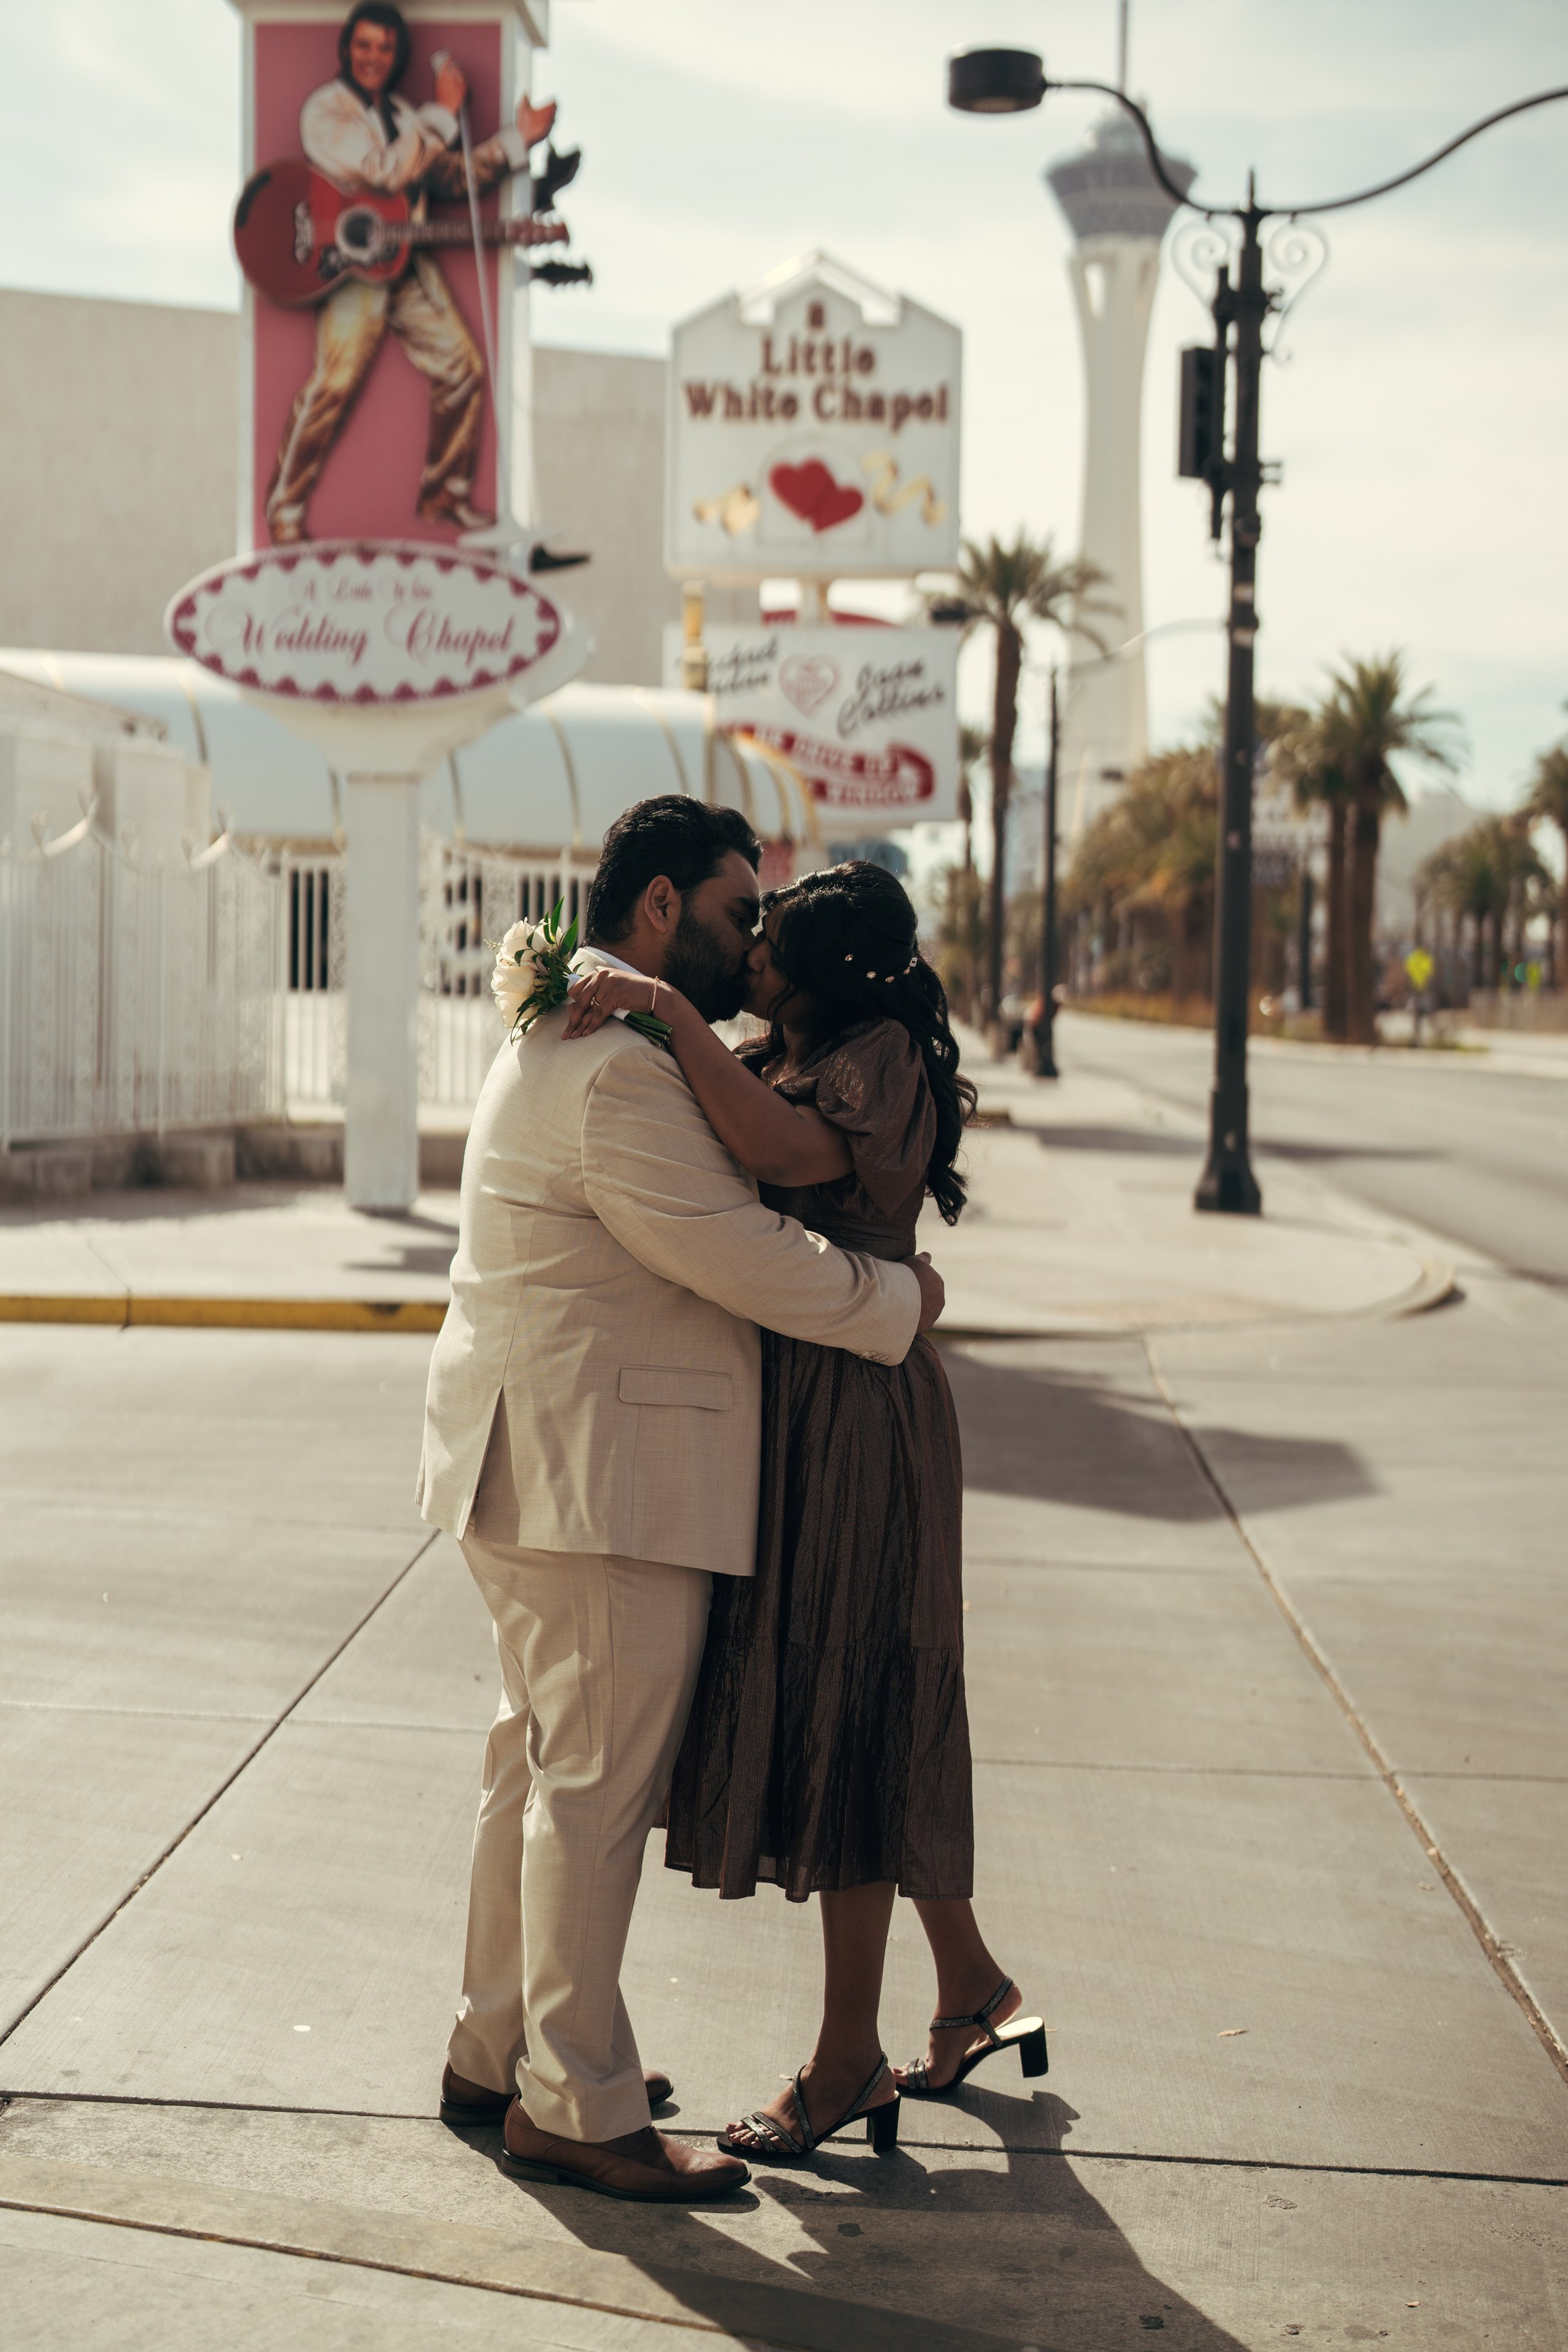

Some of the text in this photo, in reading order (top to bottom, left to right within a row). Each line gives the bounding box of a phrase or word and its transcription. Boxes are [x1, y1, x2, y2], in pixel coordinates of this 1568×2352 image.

[762, 334, 876, 376] Little
[683, 380, 949, 434] White Chapel
[210, 601, 514, 668] Wedding Chapel
[837, 681, 945, 739] Collins
